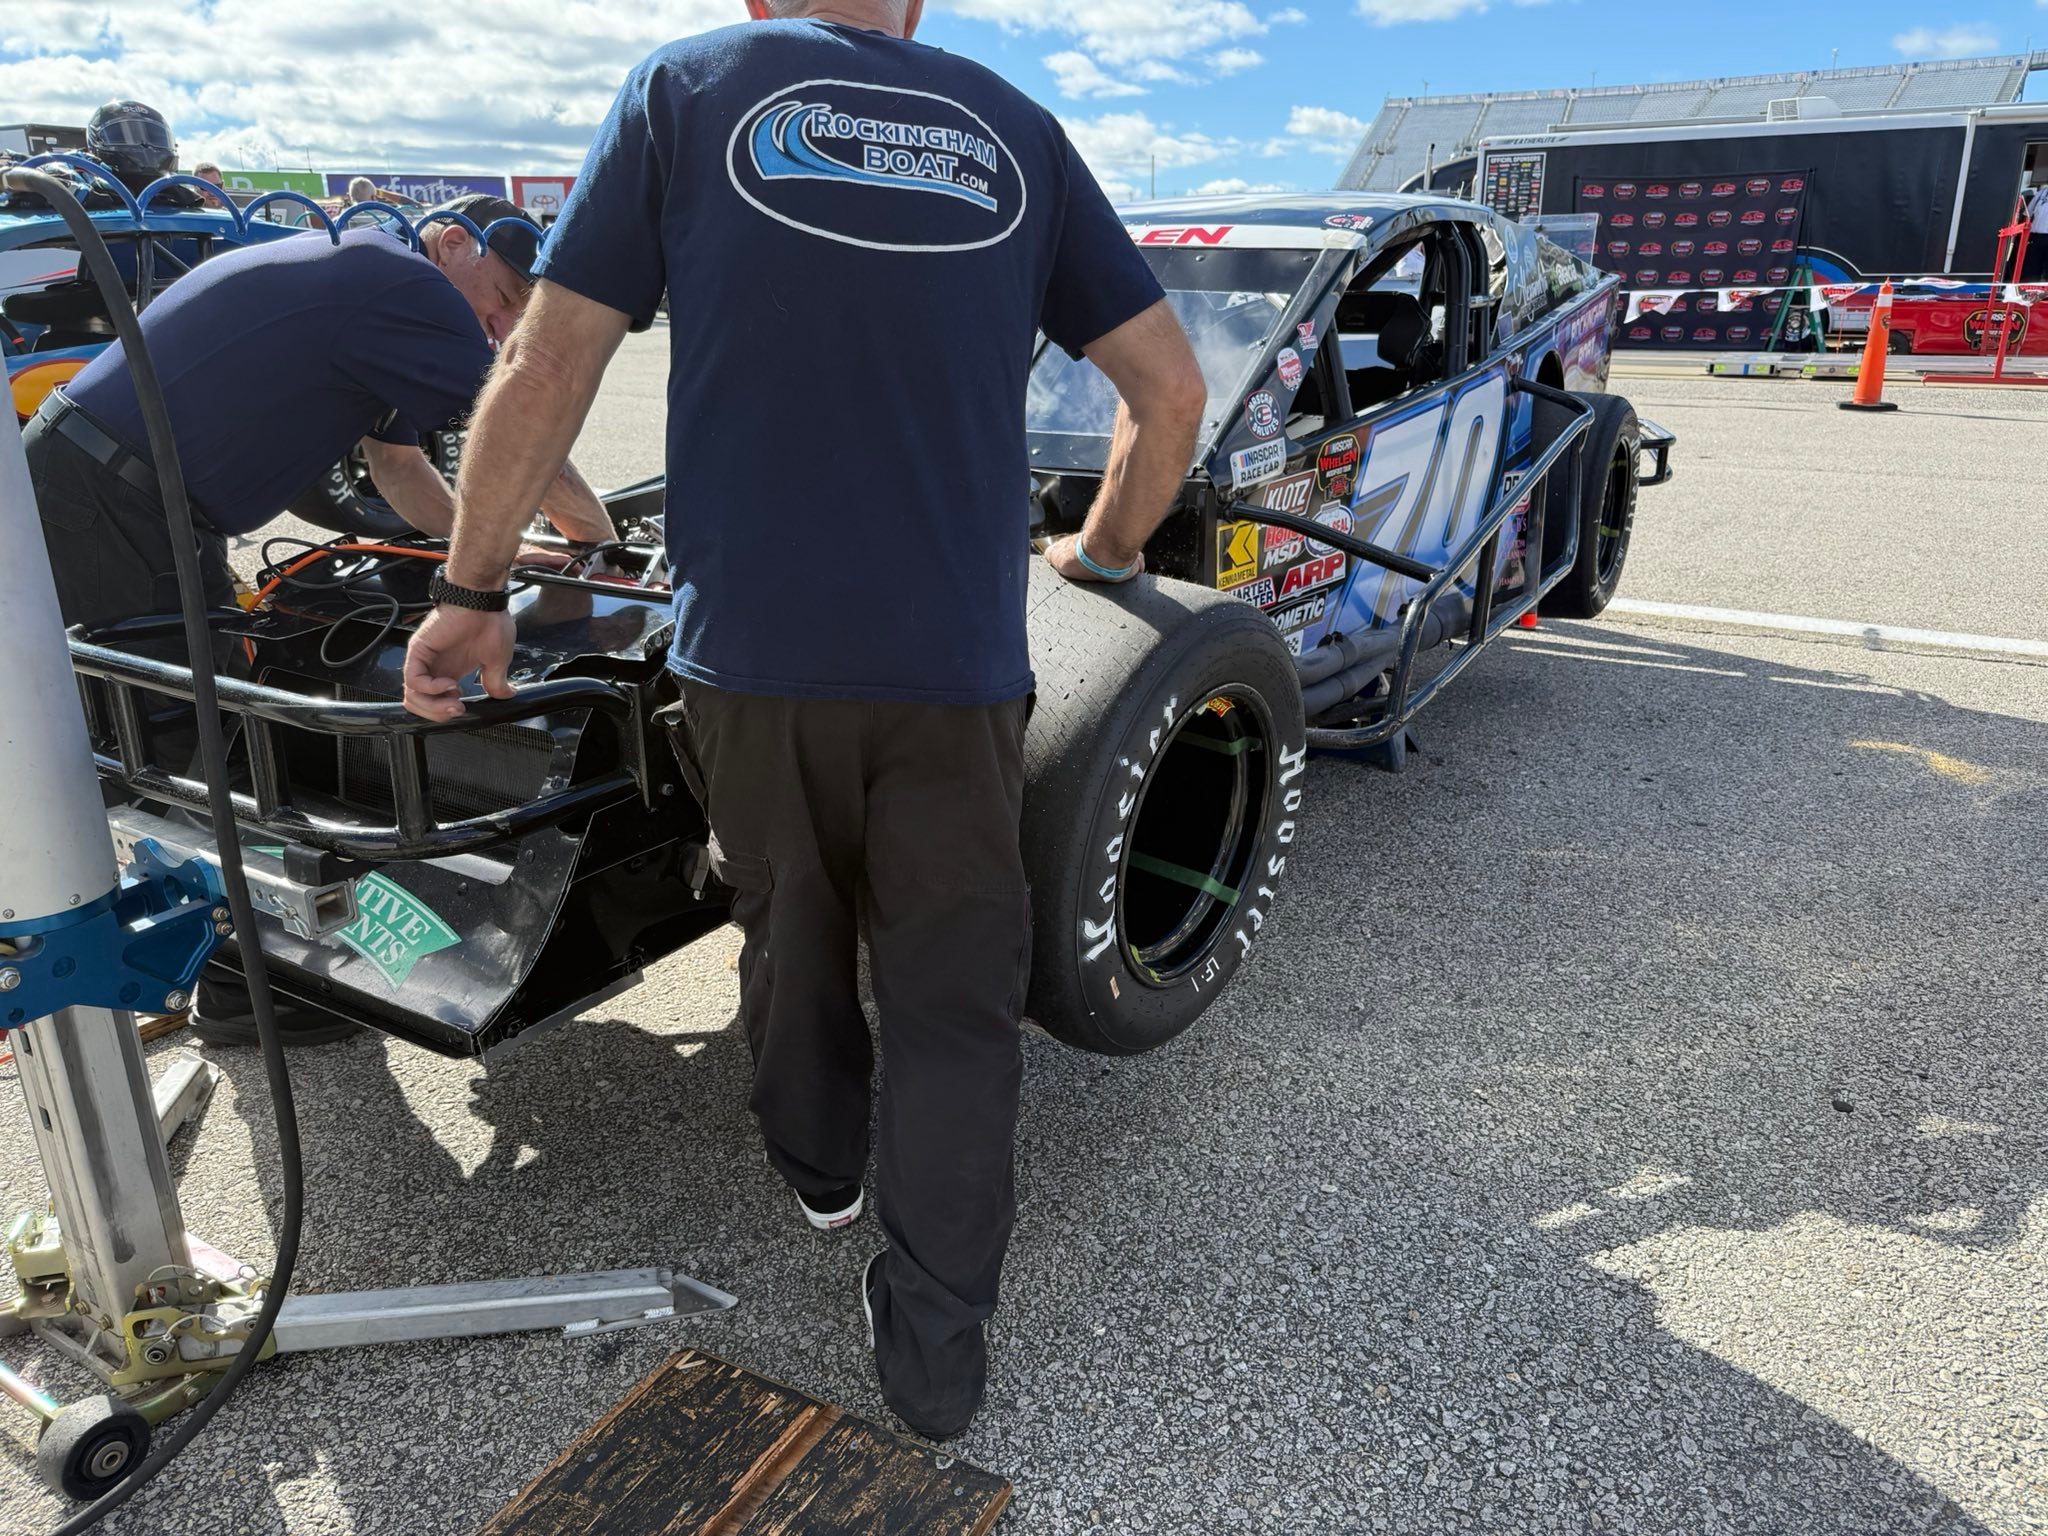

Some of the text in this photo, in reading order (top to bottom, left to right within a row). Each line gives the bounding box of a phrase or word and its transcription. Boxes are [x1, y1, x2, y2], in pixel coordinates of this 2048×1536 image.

[811, 111, 997, 174] ROCKINGHAM
[1133, 226, 1234, 244] EN
[1248, 393, 1274, 412] NASCAR
[1252, 417, 1279, 437] SALUTES
[1246, 444, 1279, 467] NASCAR
[1320, 448, 1357, 471] WHELEN
[1240, 460, 1280, 484] RACE CAR
[1266, 478, 1311, 512] KLOTZ
[1336, 375, 1505, 629] 70
[1332, 516, 1349, 531] SEAL
[1263, 541, 1301, 570] MSD
[1281, 552, 1345, 596] ARP
[343, 912, 408, 965] NTS
